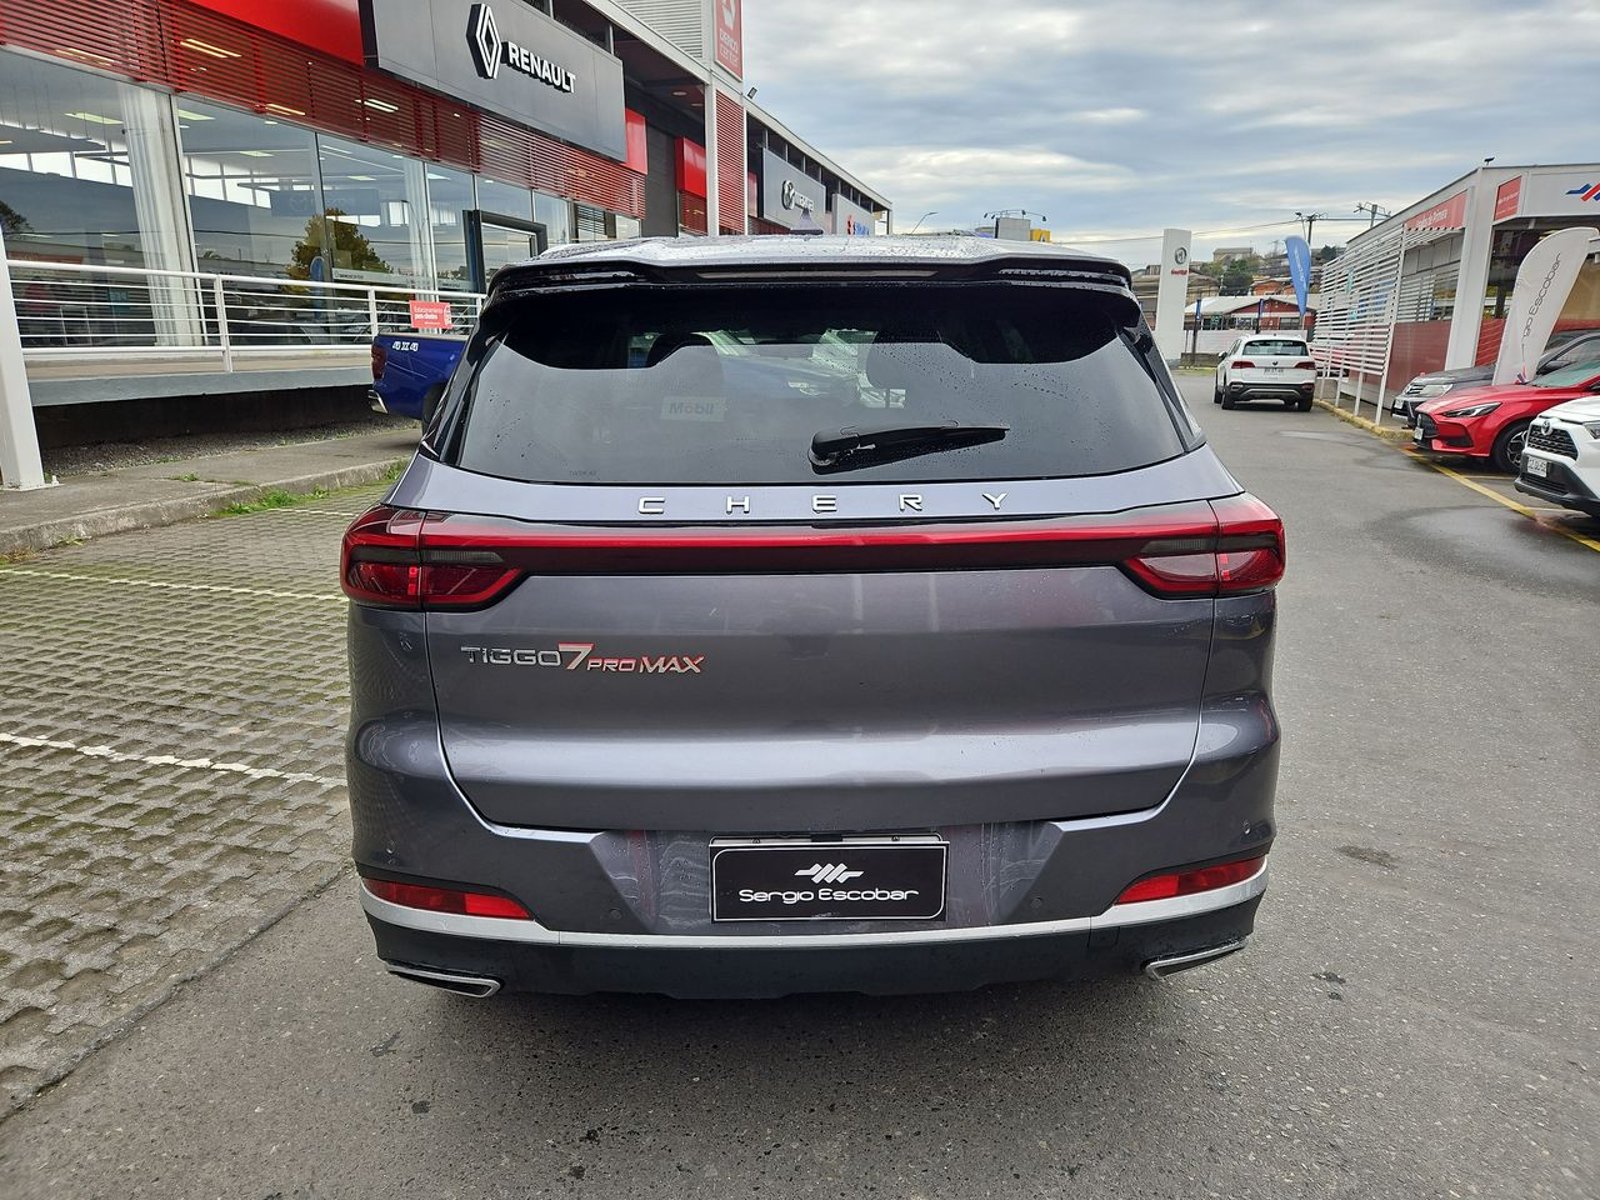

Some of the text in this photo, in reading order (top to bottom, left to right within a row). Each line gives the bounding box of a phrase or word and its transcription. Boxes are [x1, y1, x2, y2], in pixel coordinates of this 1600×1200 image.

[507, 41, 576, 93] RENAULT
[1529, 252, 1562, 316] Escobar
[669, 401, 715, 415] Mobil
[638, 493, 1008, 514] CHERY
[460, 641, 705, 674] TIGGO 7 PRO MAX
[738, 887, 920, 905] Sergio Escobar
